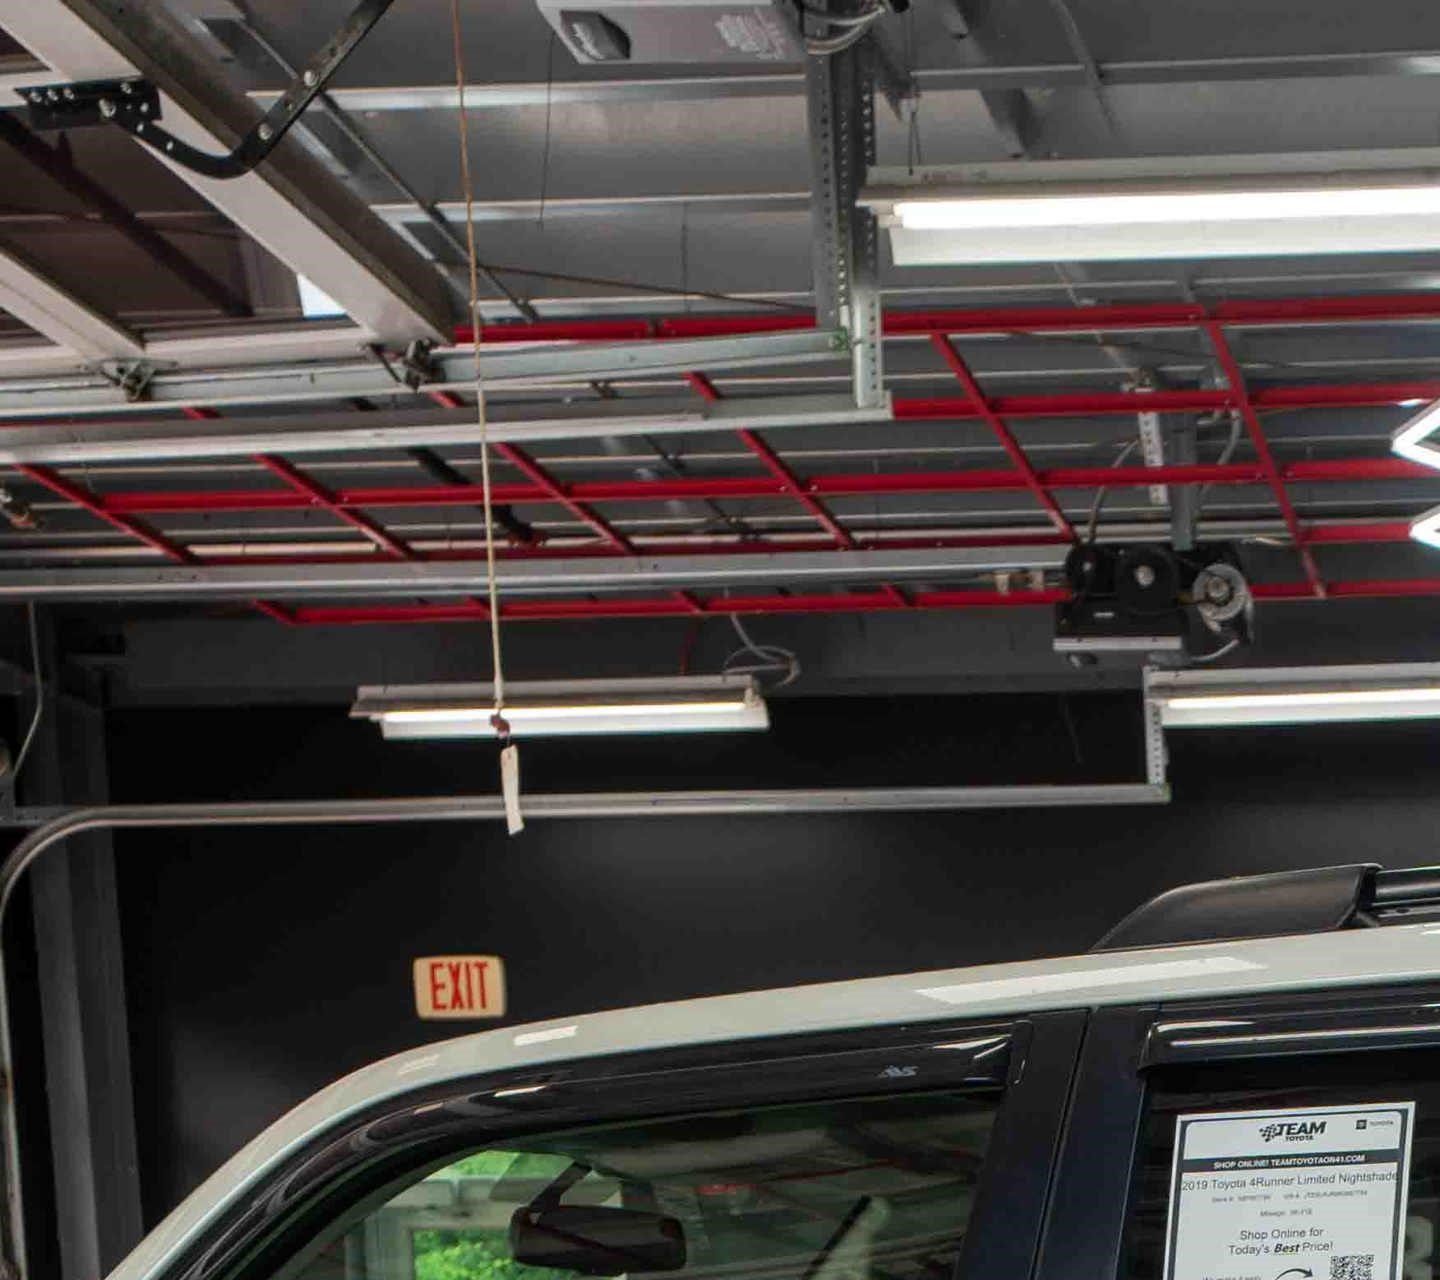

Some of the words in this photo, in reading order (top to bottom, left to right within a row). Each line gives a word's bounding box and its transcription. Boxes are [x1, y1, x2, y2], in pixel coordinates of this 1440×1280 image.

[429, 960, 489, 1011] EXIT
[1276, 1121, 1327, 1136] TEAM
[1213, 1160, 1236, 1169] SHOP
[1182, 1181, 1208, 1191] 2019
[1211, 1178, 1247, 1191] Toyota
[1249, 1176, 1294, 1187] 4Runner
[1297, 1173, 1336, 1185] Limited
[1338, 1170, 1399, 1186] Nightshade
[1240, 1230, 1268, 1242] Shop
[1271, 1228, 1306, 1240] Online
[1309, 1227, 1325, 1238] for
[1229, 1242, 1271, 1256] Today's
[1273, 1242, 1301, 1254] Best
[1302, 1241, 1334, 1252] Price!
